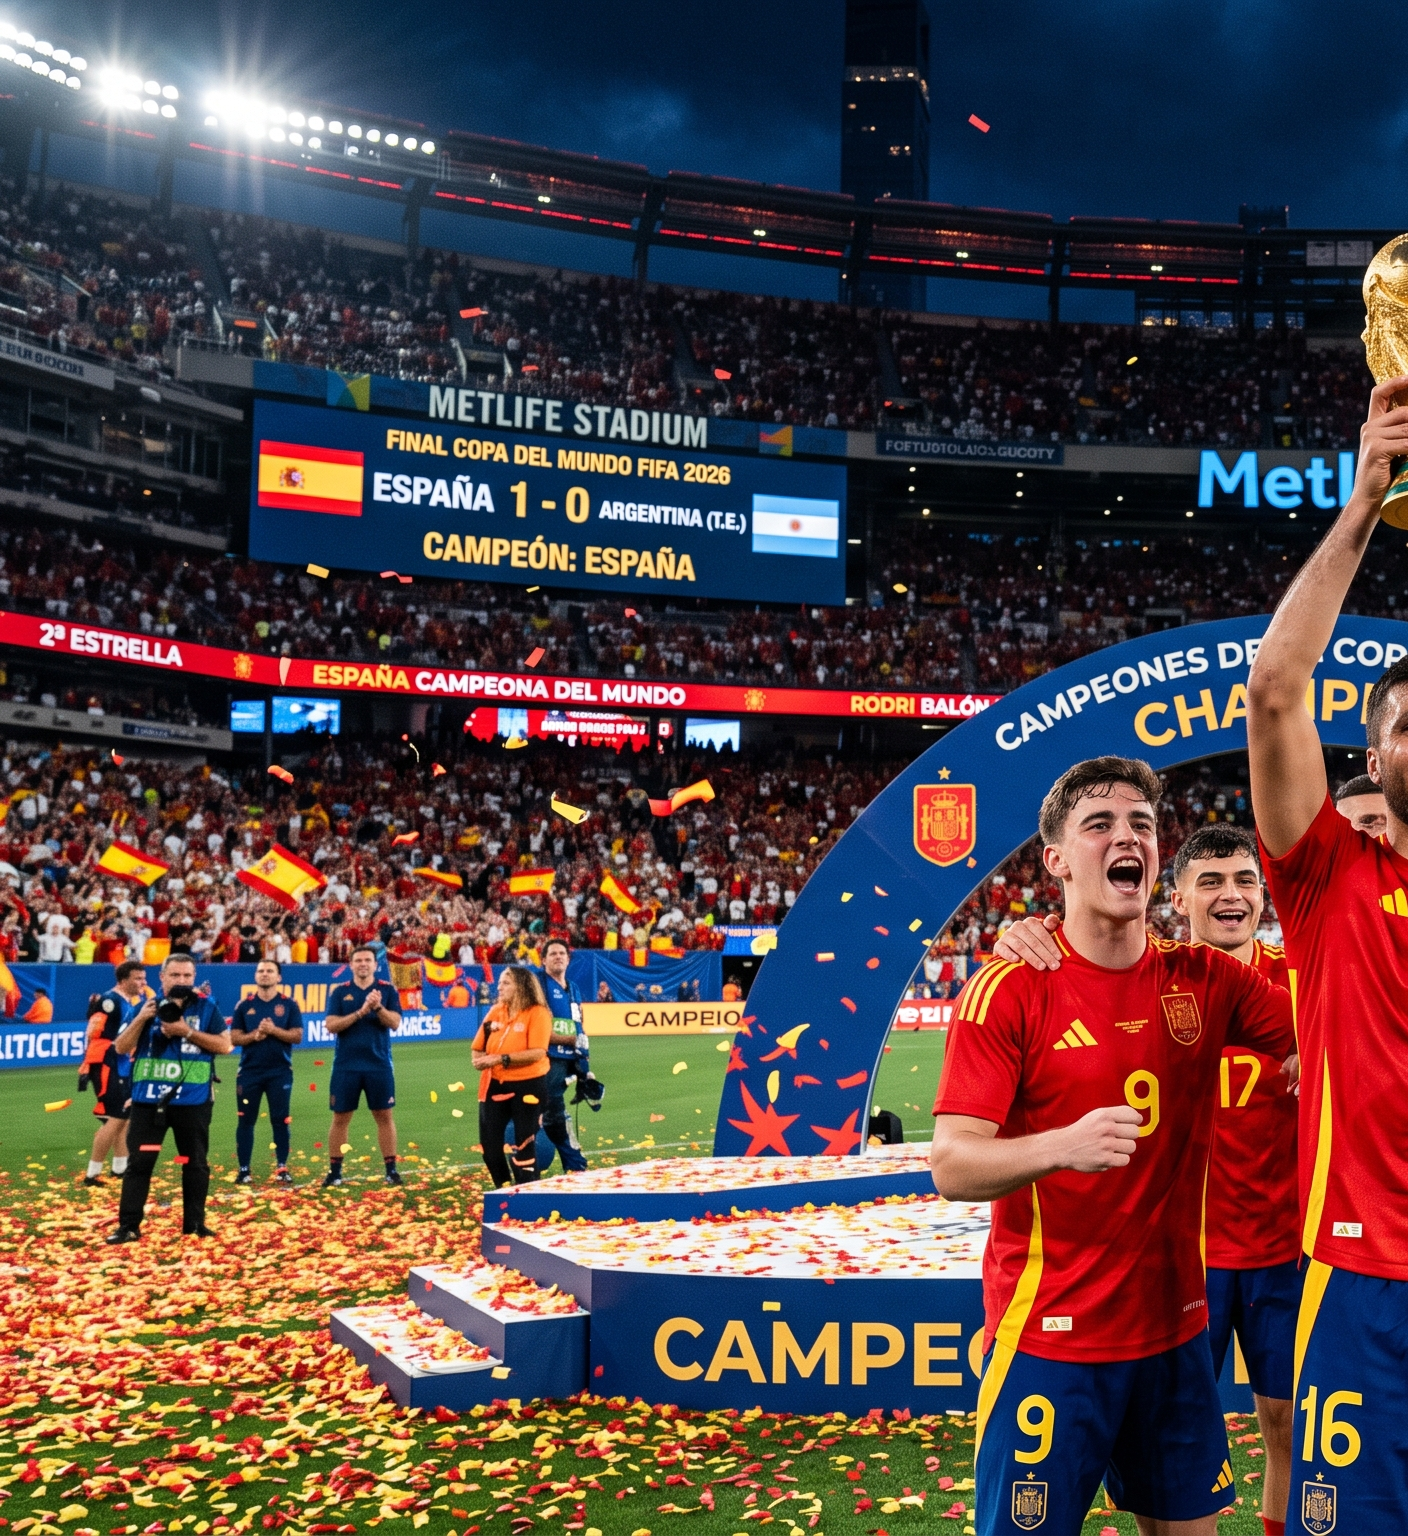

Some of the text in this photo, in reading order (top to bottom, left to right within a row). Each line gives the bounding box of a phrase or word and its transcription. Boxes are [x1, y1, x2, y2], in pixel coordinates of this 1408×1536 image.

[429, 385, 708, 448] METLIFE STADIUM
[386, 429, 731, 485] FINAL COPA DEL MUNDO FIFA 2026
[373, 472, 495, 512] ESPAÑA
[510, 480, 528, 518] 1
[565, 486, 590, 524] 0
[599, 500, 703, 528] ARGENTINA
[707, 512, 747, 535] (T.E.)
[423, 531, 696, 581] CAMPEÓN: ESPAÑA
[70, 628, 183, 667] ESTRELLA
[312, 663, 686, 706] ESPAÑA CAMPEONA DEL MUNDO
[851, 695, 989, 716] RODRI BALÓN
[995, 647, 1209, 750] CAMPEONES
[1124, 1070, 1159, 1137] 9
[653, 1316, 986, 1386] CAMPE
[1014, 1394, 1055, 1464] 9
[1300, 1385, 1363, 1467] 16
